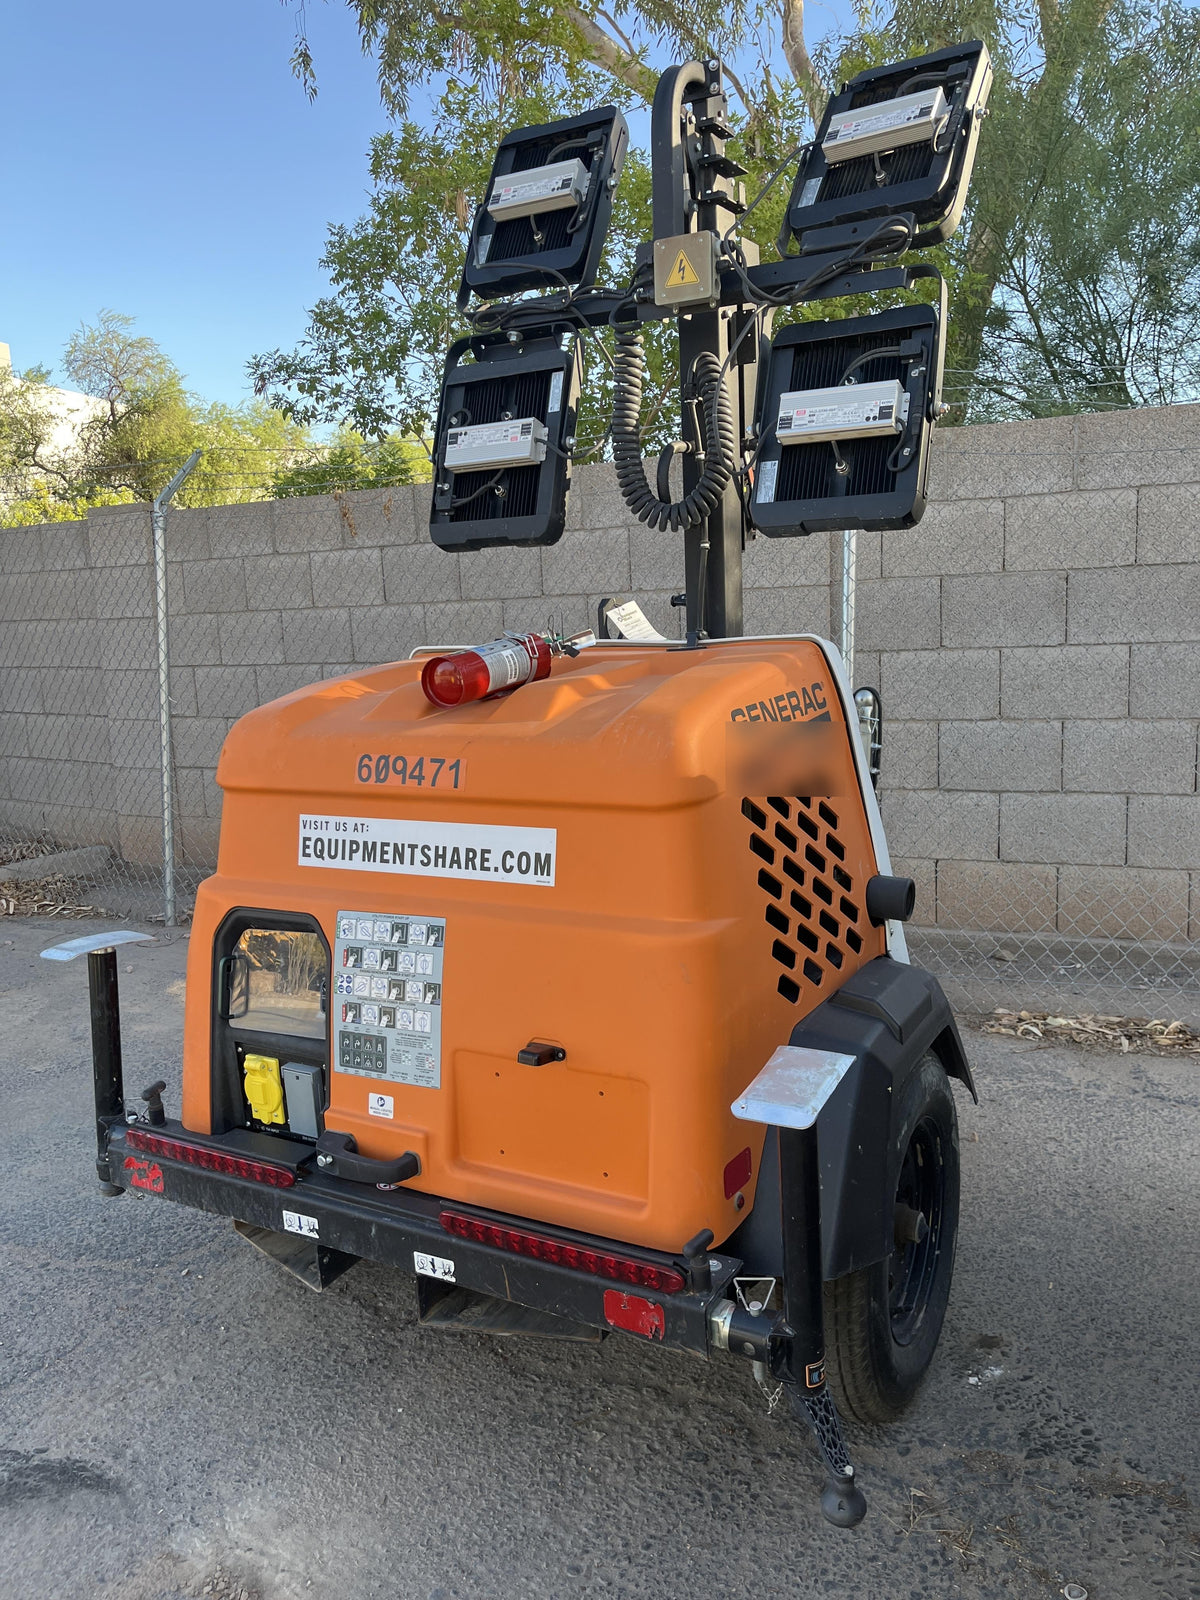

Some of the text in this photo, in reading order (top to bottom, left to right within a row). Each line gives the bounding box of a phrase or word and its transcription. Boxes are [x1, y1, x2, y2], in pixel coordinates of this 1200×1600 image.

[357, 753, 461, 789] 609471
[302, 819, 370, 833] VISIT US AT:
[302, 836, 552, 877] EQUIPMENTSHARE.COM
